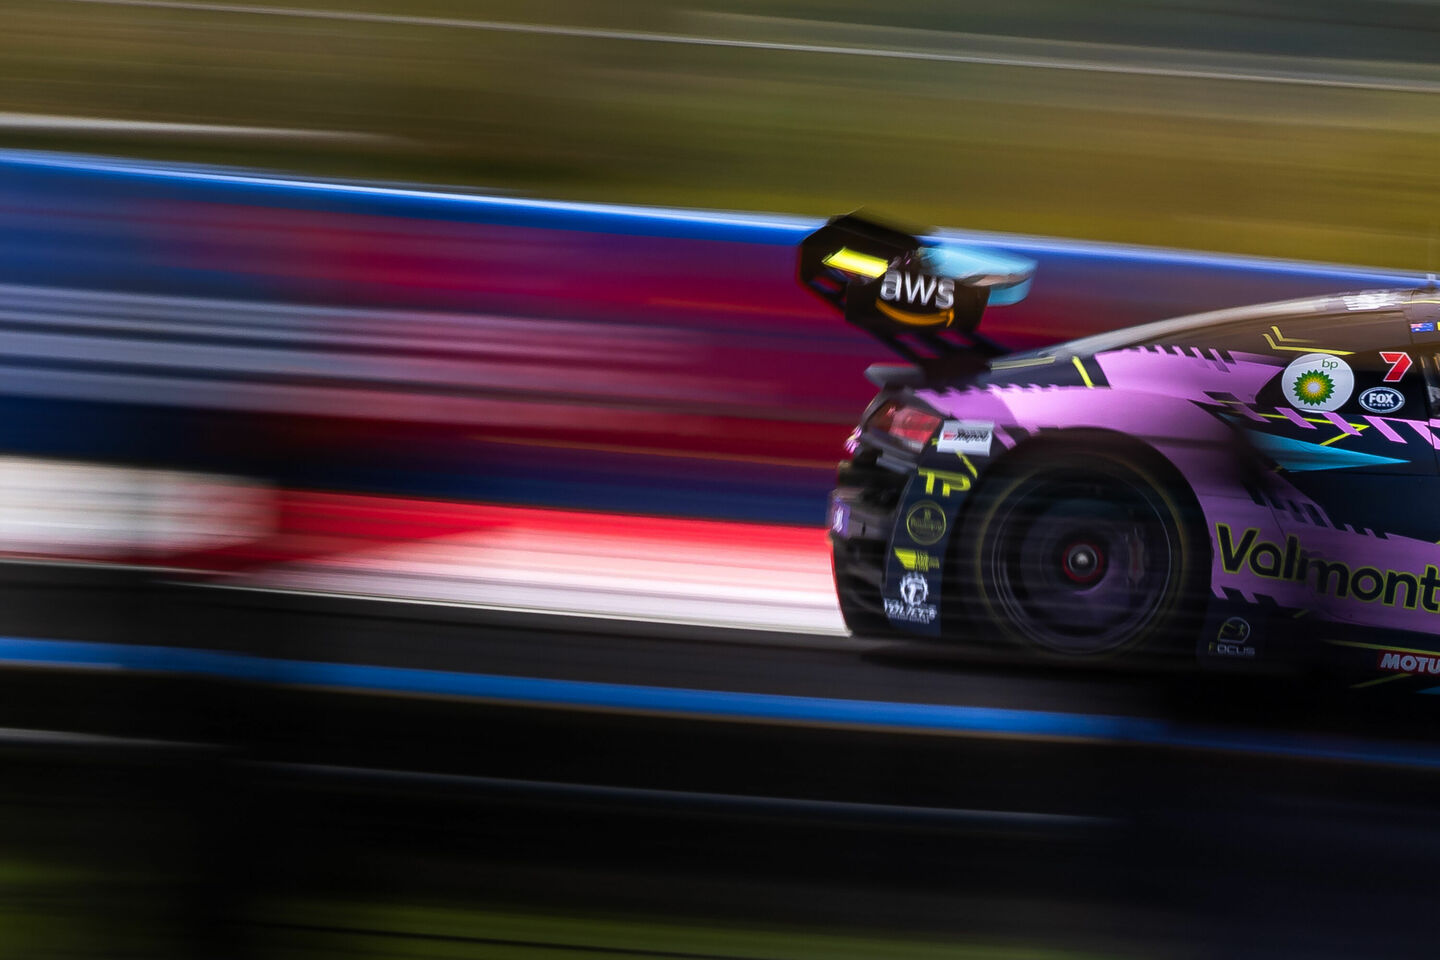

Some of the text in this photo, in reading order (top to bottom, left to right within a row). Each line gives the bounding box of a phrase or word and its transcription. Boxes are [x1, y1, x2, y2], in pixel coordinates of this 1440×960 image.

[880, 270, 955, 309] aws
[1321, 359, 1339, 370] bp
[1379, 351, 1413, 382] 7
[1368, 393, 1395, 403] FOX
[1208, 642, 1256, 656] FOCUS
